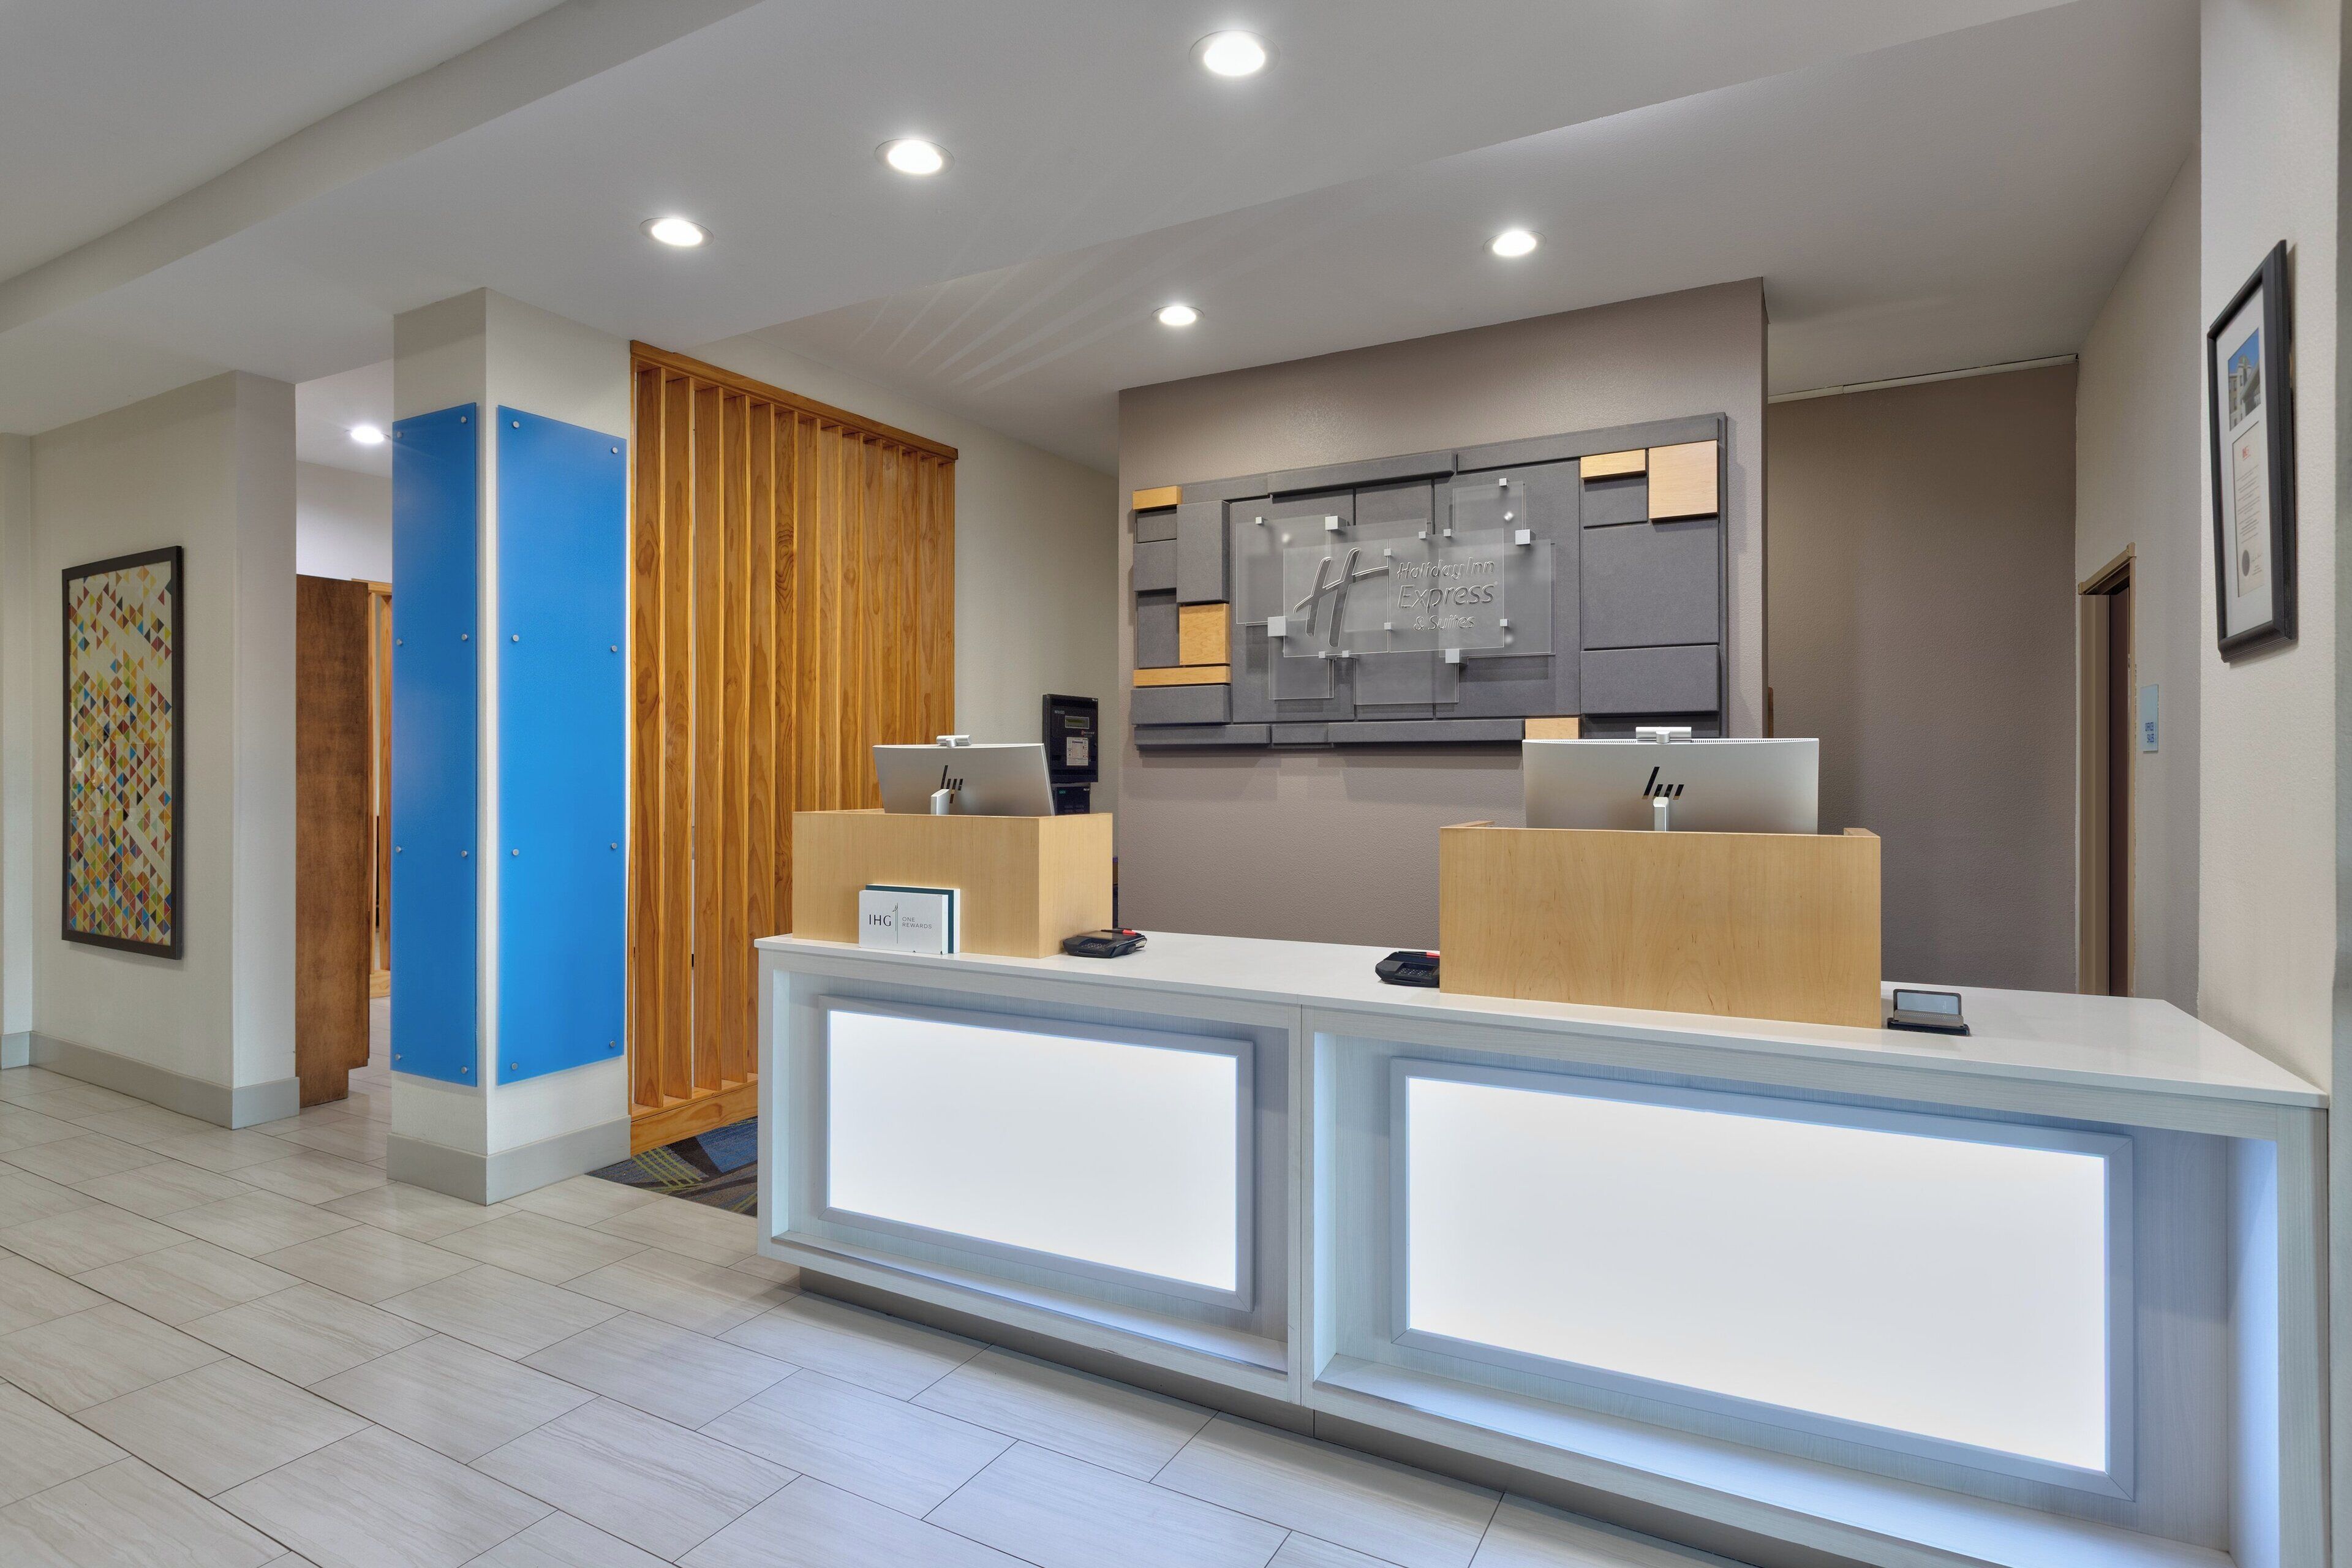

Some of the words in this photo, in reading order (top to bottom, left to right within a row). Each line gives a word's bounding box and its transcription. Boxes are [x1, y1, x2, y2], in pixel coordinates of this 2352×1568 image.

[1396, 559, 1464, 580] Holiday
[1466, 557, 1495, 575] Inn
[1397, 584, 1495, 613] Express
[1414, 616, 1425, 631] &
[1428, 614, 1475, 630] Suites
[869, 914, 891, 927] IHG
